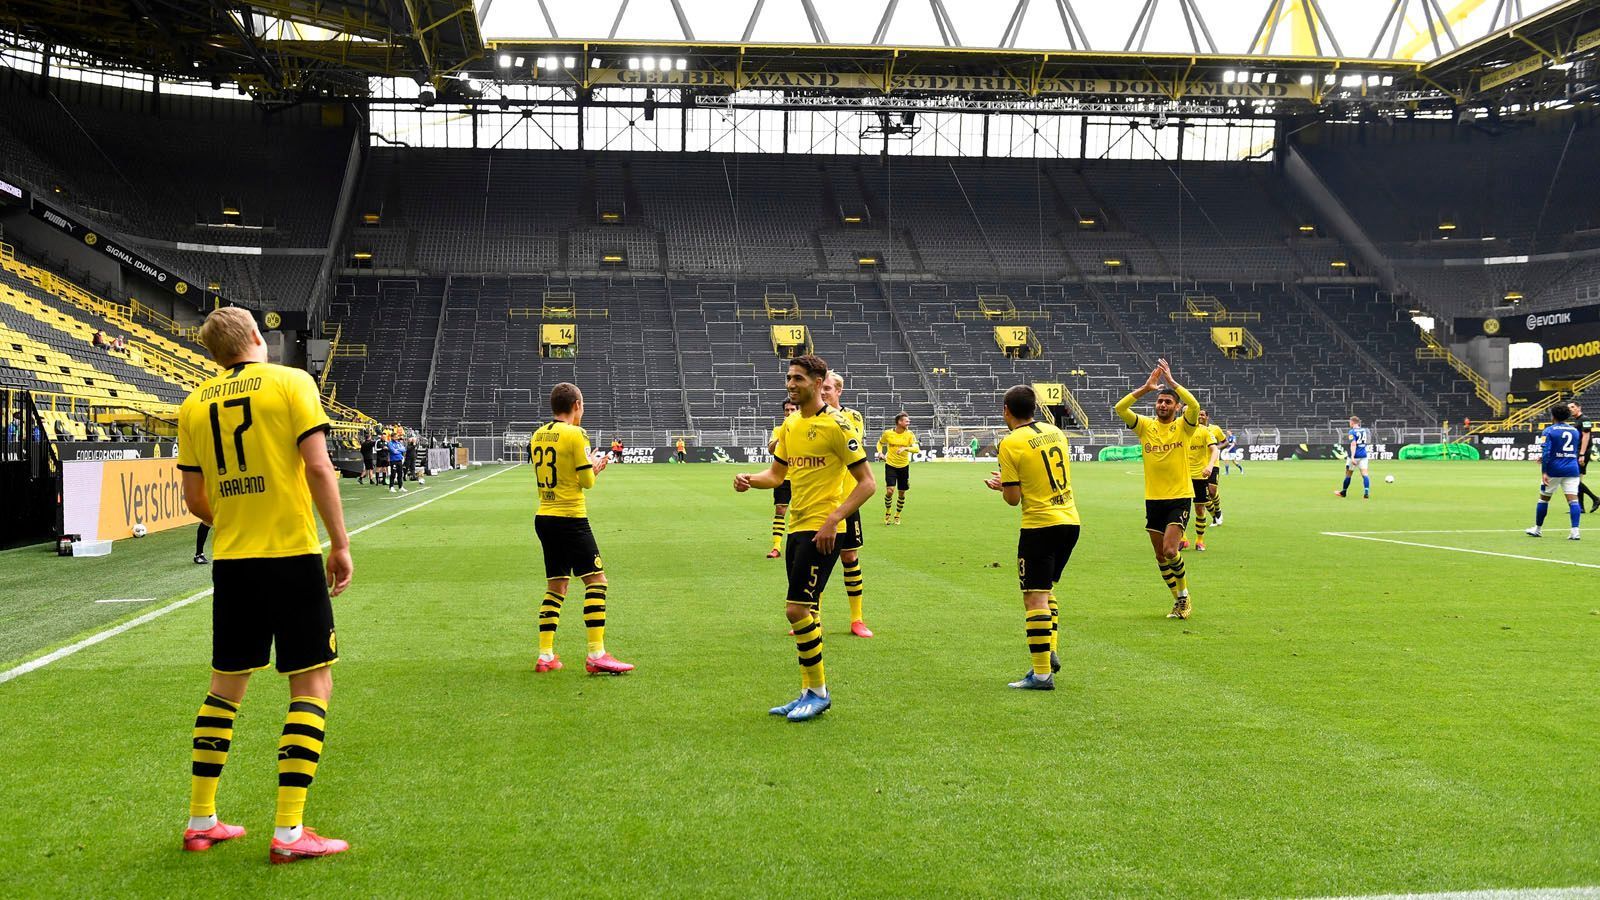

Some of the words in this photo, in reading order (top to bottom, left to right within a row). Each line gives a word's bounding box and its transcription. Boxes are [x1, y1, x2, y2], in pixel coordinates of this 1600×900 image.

[616, 69, 725, 85] GELBE
[745, 71, 840, 87] WAND
[889, 74, 1097, 93] SÜDTRIBÜNE
[1108, 79, 1288, 98] DORTMUND
[43, 210, 67, 228] PUMA
[105, 244, 134, 265] SIGNAL
[134, 260, 158, 278] IDUNA
[1536, 312, 1571, 326] EVONIK
[560, 328, 572, 340] 14
[790, 329, 802, 340] 13
[1012, 330, 1024, 341] 12
[1229, 331, 1239, 342] 11
[200, 376, 263, 403] DORTMUND
[1046, 387, 1060, 399] 12
[209, 396, 253, 476] 17
[1356, 430, 1368, 444] 24
[1562, 430, 1575, 452] 2
[622, 447, 656, 456] SAFETY
[743, 447, 758, 456] TAKE
[760, 447, 770, 456] TH
[1074, 445, 1085, 454] THE
[1248, 444, 1280, 453] SAFETY
[1375, 444, 1386, 452] THE
[1492, 444, 1526, 460] atlas
[623, 455, 654, 464] SHOES
[748, 455, 764, 463] NEXT
[1079, 453, 1093, 461] STEP
[1250, 452, 1278, 461] SHOES
[1380, 451, 1394, 460] STEP
[533, 445, 558, 489] 23
[1041, 445, 1067, 493] 13
[218, 475, 266, 498] HAALAND
[120, 466, 191, 527] Versiche
[808, 565, 819, 588] 5
